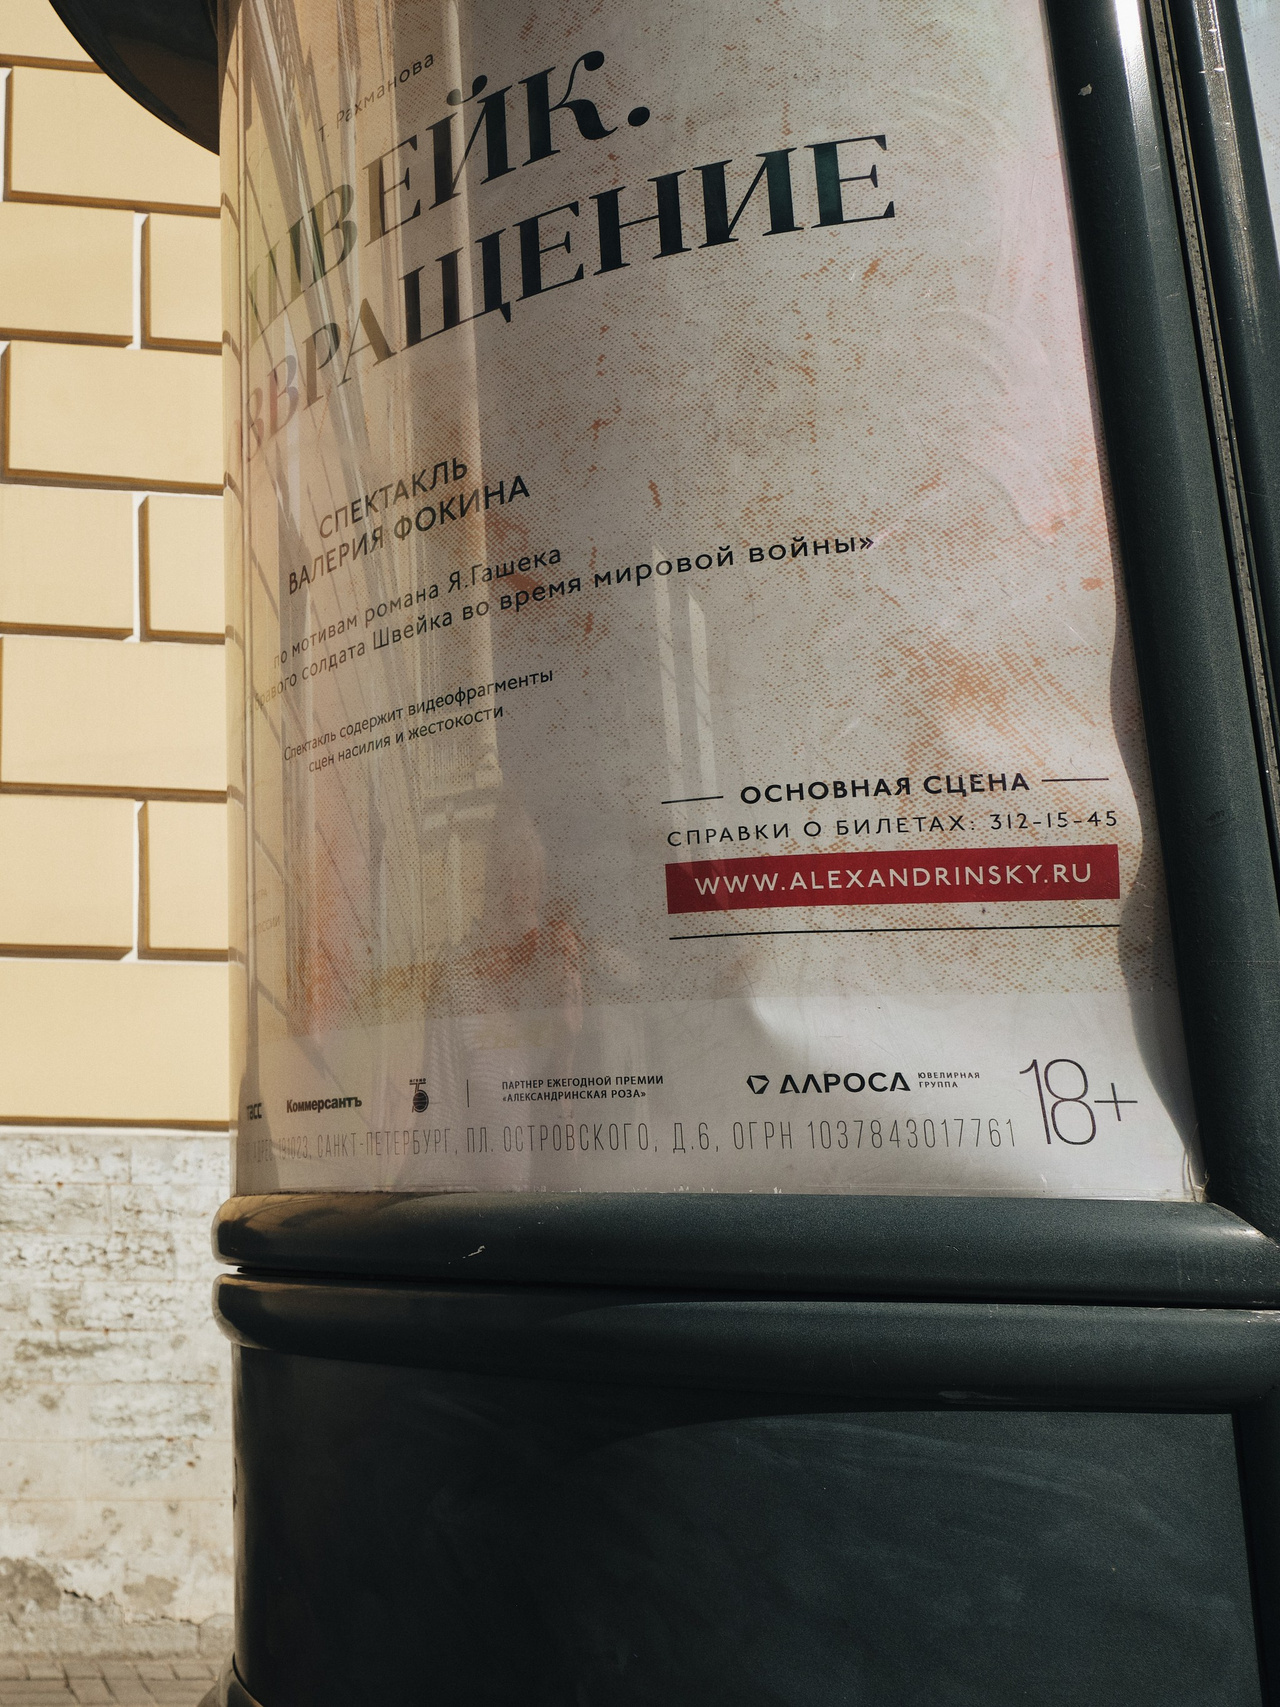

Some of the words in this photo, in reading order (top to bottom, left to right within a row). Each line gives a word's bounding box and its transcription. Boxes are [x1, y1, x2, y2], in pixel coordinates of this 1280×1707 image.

[337, 54, 434, 129] Рахманова
[319, 457, 468, 539] СПЕКТАКЛЬ
[289, 526, 384, 595] ВАЛЕРИЯ
[394, 475, 530, 541] ФОКИНА
[273, 650, 288, 669] по
[292, 614, 358, 657] мотивам
[365, 583, 439, 628] романа
[302, 642, 365, 680] солдата
[372, 612, 453, 650] Швейка
[462, 600, 490, 621] во
[500, 575, 581, 612] время
[594, 545, 734, 587] мировой
[749, 536, 875, 563] войны»
[284, 731, 337, 761] Спектакль
[339, 707, 403, 738] содержит
[408, 670, 553, 715] видеофрагменты
[308, 752, 335, 772] сцен
[338, 734, 391, 762] насилия
[396, 731, 404, 744] и
[408, 706, 503, 740] жестокости
[740, 777, 912, 804] ОСНОВНАЯ
[923, 772, 1030, 798] СЦЕНА
[667, 823, 790, 847] СПРАВКИ
[803, 820, 821, 838] О
[836, 815, 976, 836] БИЛЕТАХ:
[990, 810, 1118, 832] 312-15-45
[695, 863, 1092, 896] WWW.ALEXANDRINSKY.RU
[286, 1097, 363, 1113] Коммерсантъ
[502, 1079, 544, 1090] ПАРТНЕР
[547, 1076, 611, 1088] ЕЖЕГОДНОЙ
[615, 1075, 664, 1086] ПРЕМИИ
[502, 1090, 607, 1102] «АЛЕКСАНДРИНСКАЯ
[611, 1089, 646, 1099] РОЗА»
[1019, 1058, 1138, 1145] 18+
[317, 1128, 458, 1160] САНКТ-ПЕТЕРБУРГ,
[467, 1127, 494, 1153] ПЛ.
[503, 1122, 659, 1153] ОСТРОВСКОГО,
[672, 1122, 719, 1154] Д.6,
[732, 1121, 793, 1151] ОГРН
[808, 1118, 1015, 1151] 1037843017761
